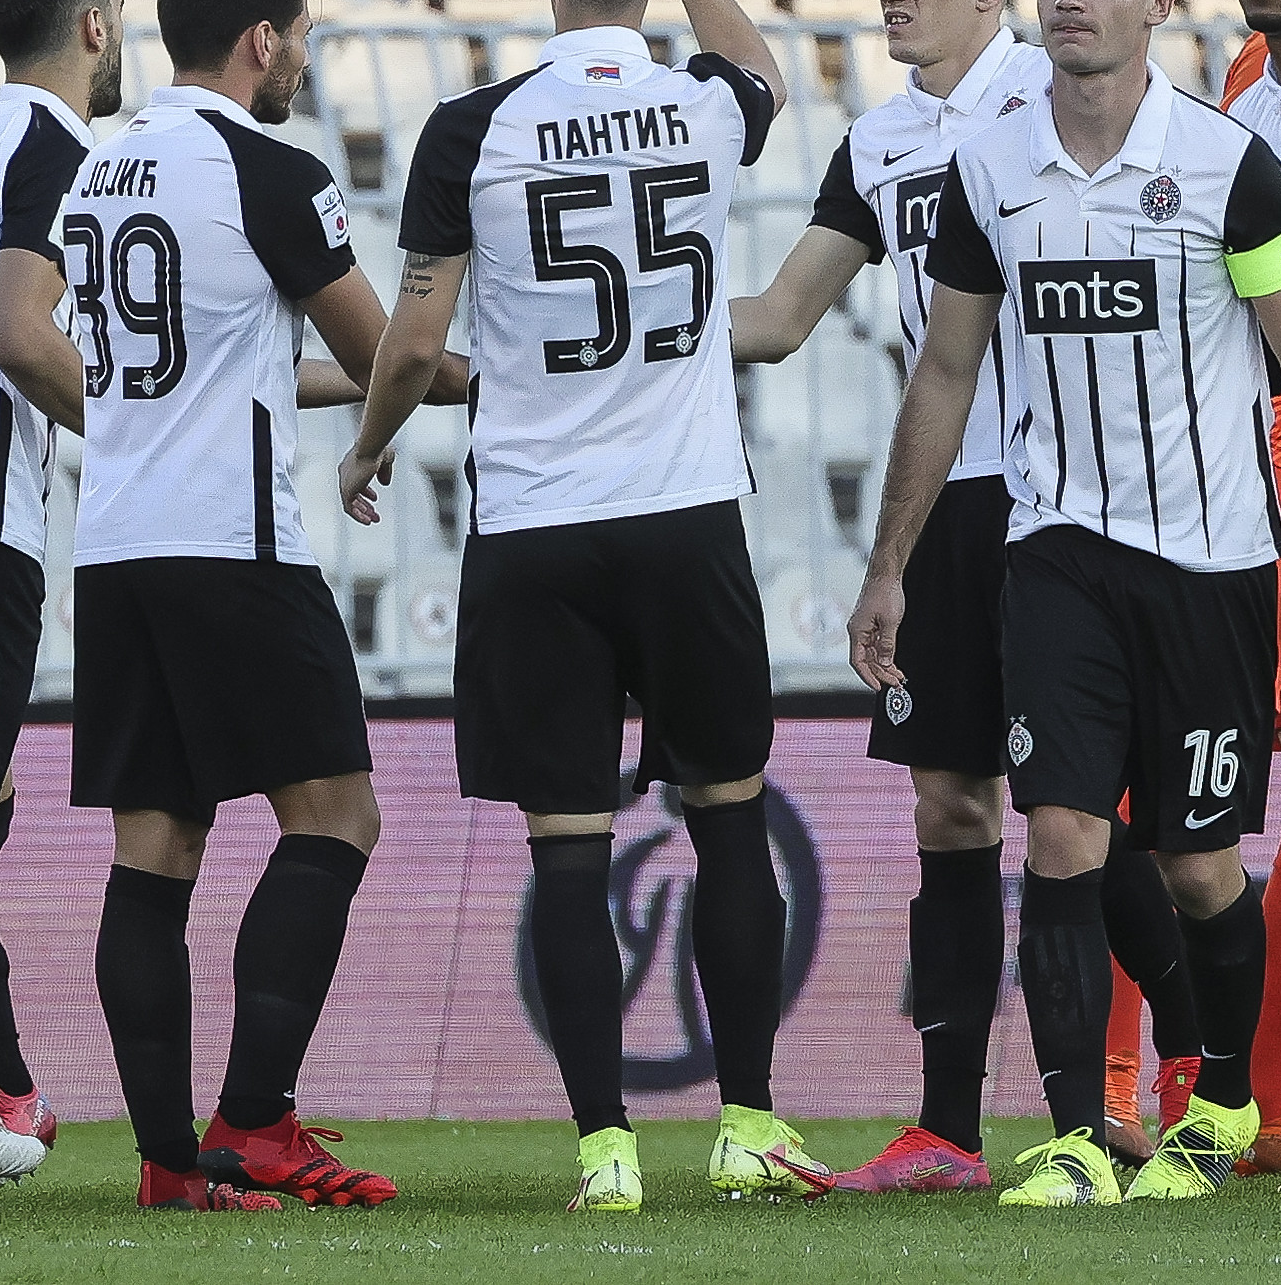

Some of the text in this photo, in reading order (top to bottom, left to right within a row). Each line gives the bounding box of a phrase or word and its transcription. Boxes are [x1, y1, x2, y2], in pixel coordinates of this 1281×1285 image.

[537, 103, 690, 162] ПАНТИЋ
[81, 158, 158, 198] ЈОЈИЋ
[526, 161, 716, 375] 55
[1036, 271, 1143, 319] mts
[63, 213, 187, 400] 39
[1183, 728, 1240, 798] 16
